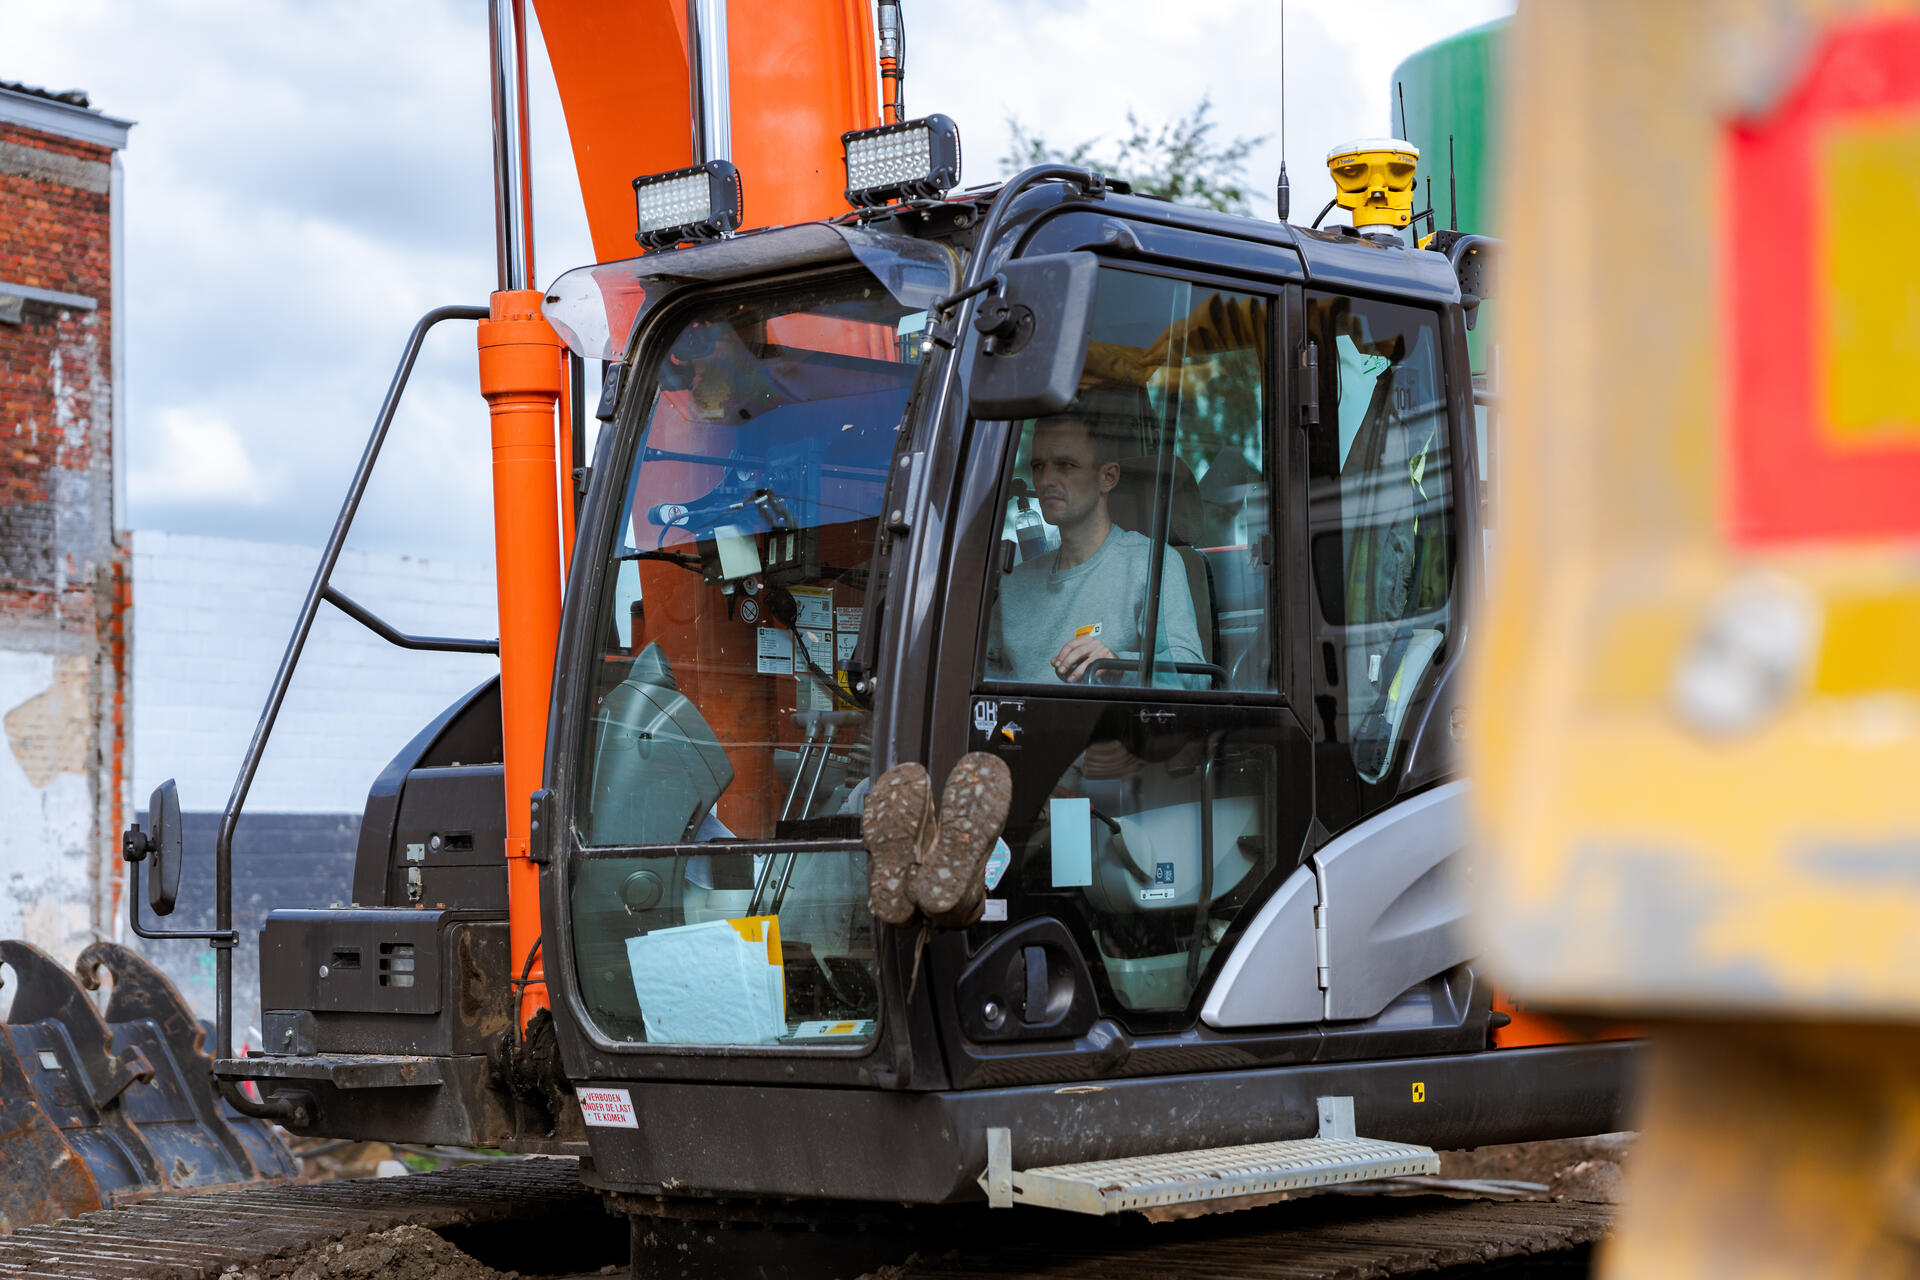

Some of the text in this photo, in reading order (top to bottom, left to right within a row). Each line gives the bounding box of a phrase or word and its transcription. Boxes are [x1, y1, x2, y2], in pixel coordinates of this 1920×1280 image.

[587, 1093, 622, 1102] VERBODEN
[606, 1103, 615, 1112] DE
[615, 1104, 632, 1112] LAST
[593, 1113, 626, 1122] TE KOMEN
